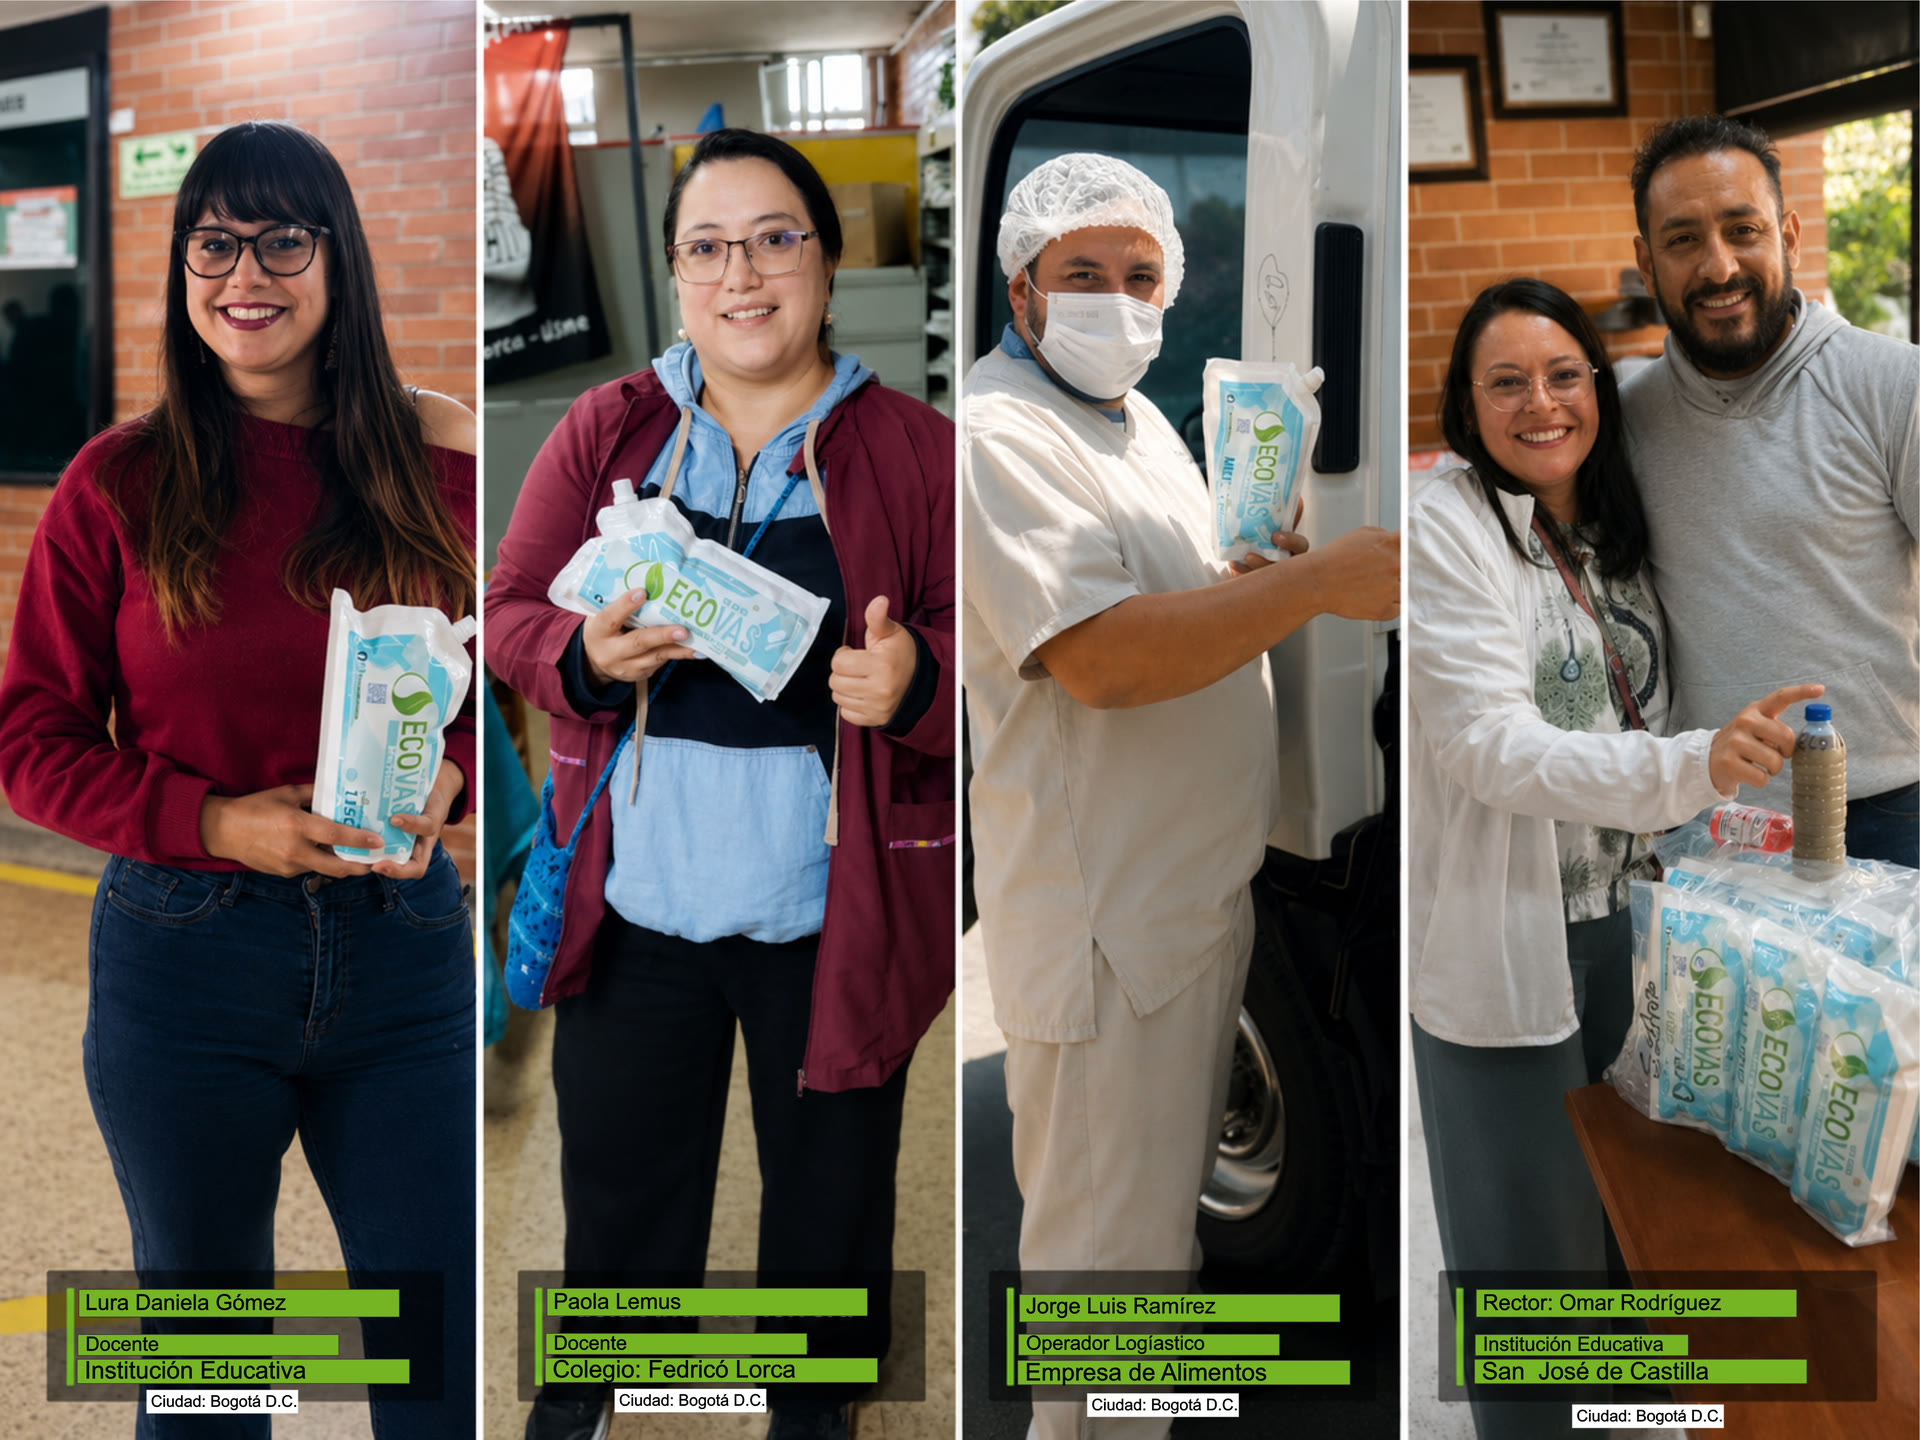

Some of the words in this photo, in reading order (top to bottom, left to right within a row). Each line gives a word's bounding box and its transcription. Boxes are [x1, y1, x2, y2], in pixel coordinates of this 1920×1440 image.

[1247, 445, 1279, 518] ECOVAS
[665, 578, 761, 654] ECOVAS
[390, 721, 428, 816] ECOVAS
[1693, 991, 1724, 1087] ECOVAS
[1752, 1034, 1789, 1140] ECOVAS
[1815, 1081, 1859, 1191] ECOVAS
